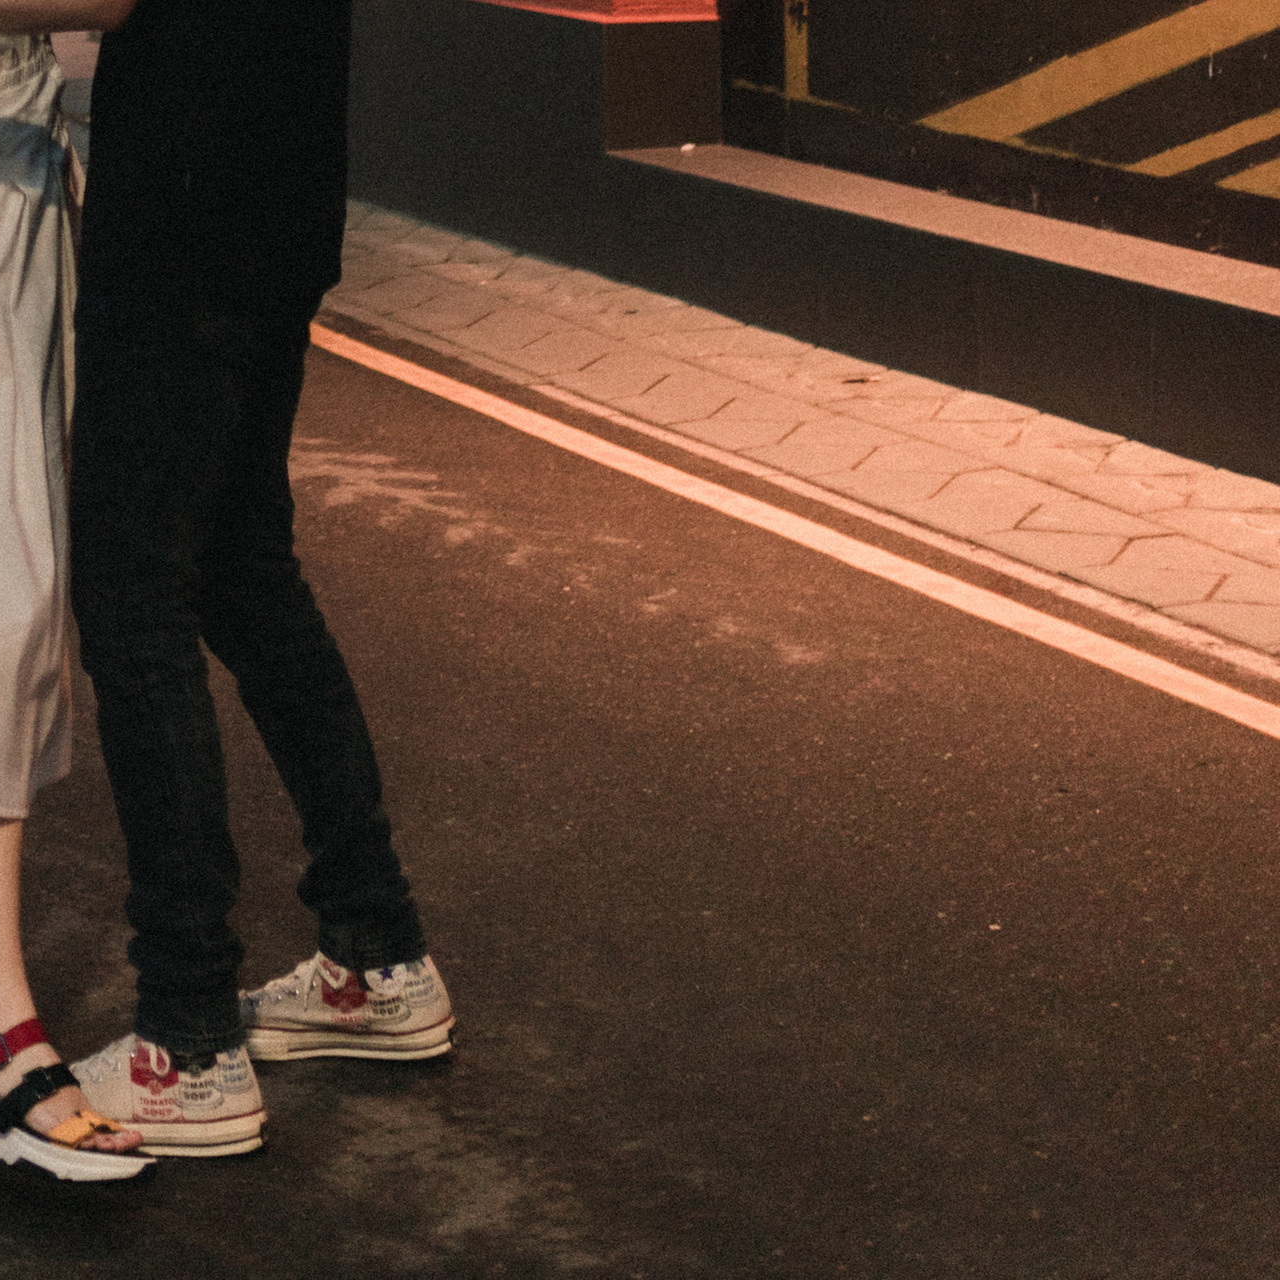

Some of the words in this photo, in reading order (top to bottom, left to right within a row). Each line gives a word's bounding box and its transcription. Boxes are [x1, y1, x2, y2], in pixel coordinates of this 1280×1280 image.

[368, 995, 403, 1007] TOMATO
[373, 1004, 401, 1016] SOUP
[179, 1078, 215, 1088] TOMATO
[183, 1089, 213, 1101] SOUP
[139, 1096, 174, 1106] TOMATO
[142, 1107, 174, 1117] SOUP
